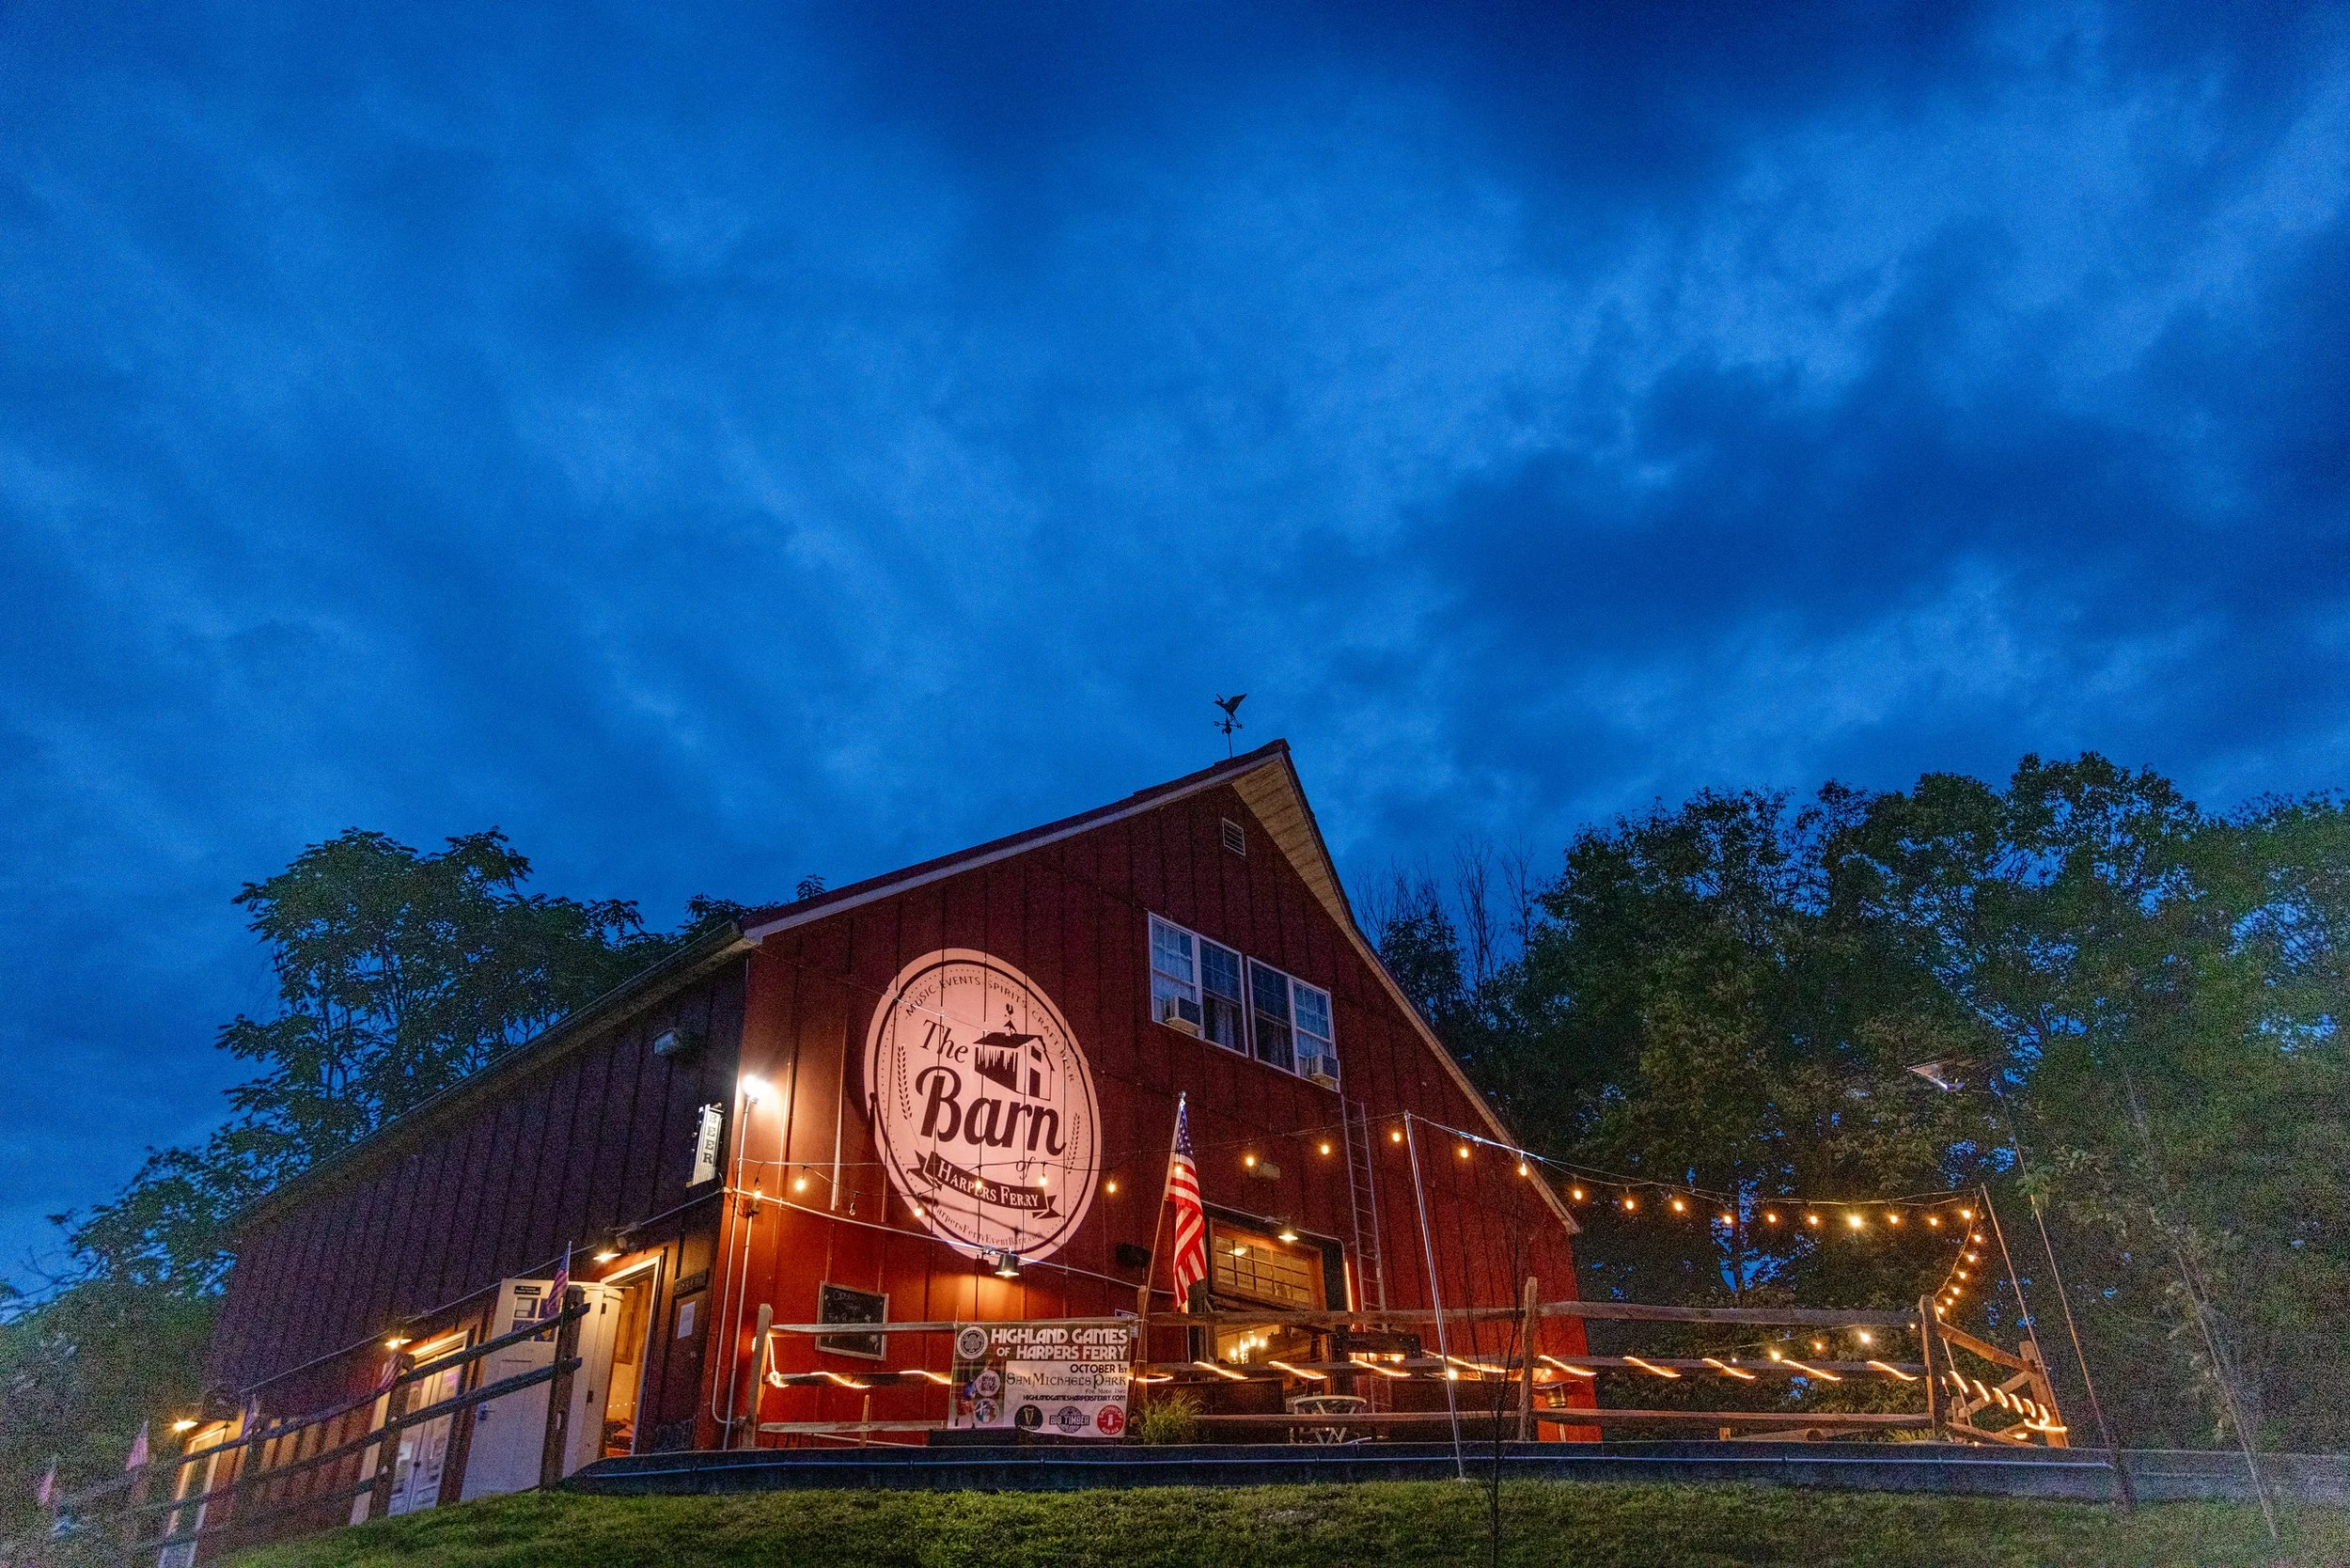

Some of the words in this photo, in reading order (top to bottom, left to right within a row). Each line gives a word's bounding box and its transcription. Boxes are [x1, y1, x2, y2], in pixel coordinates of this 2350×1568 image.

[905, 984, 936, 1017] MUSIC
[940, 975, 981, 990] EVENTS
[988, 980, 1027, 1009] SPIRITS
[920, 1019, 969, 1063] The
[915, 1065, 1067, 1156] Barn
[703, 1113, 717, 1165] BEER
[1015, 1156, 1036, 1180] of
[938, 1160, 997, 1203] HARPERS
[1000, 1185, 1039, 1207] FERRY
[991, 1328, 1068, 1344] HIGHLAND
[1072, 1329, 1128, 1345] GAMES
[996, 1347, 1010, 1356] OF
[1016, 1345, 1080, 1359] HARPERS
[1083, 1346, 1127, 1360] FERRY
[1070, 1363, 1116, 1373] OCTOBER
[1092, 1373, 1126, 1389] PARK
[1050, 1415, 1062, 1425] BIG
[1064, 1416, 1089, 1426] TIMBER
